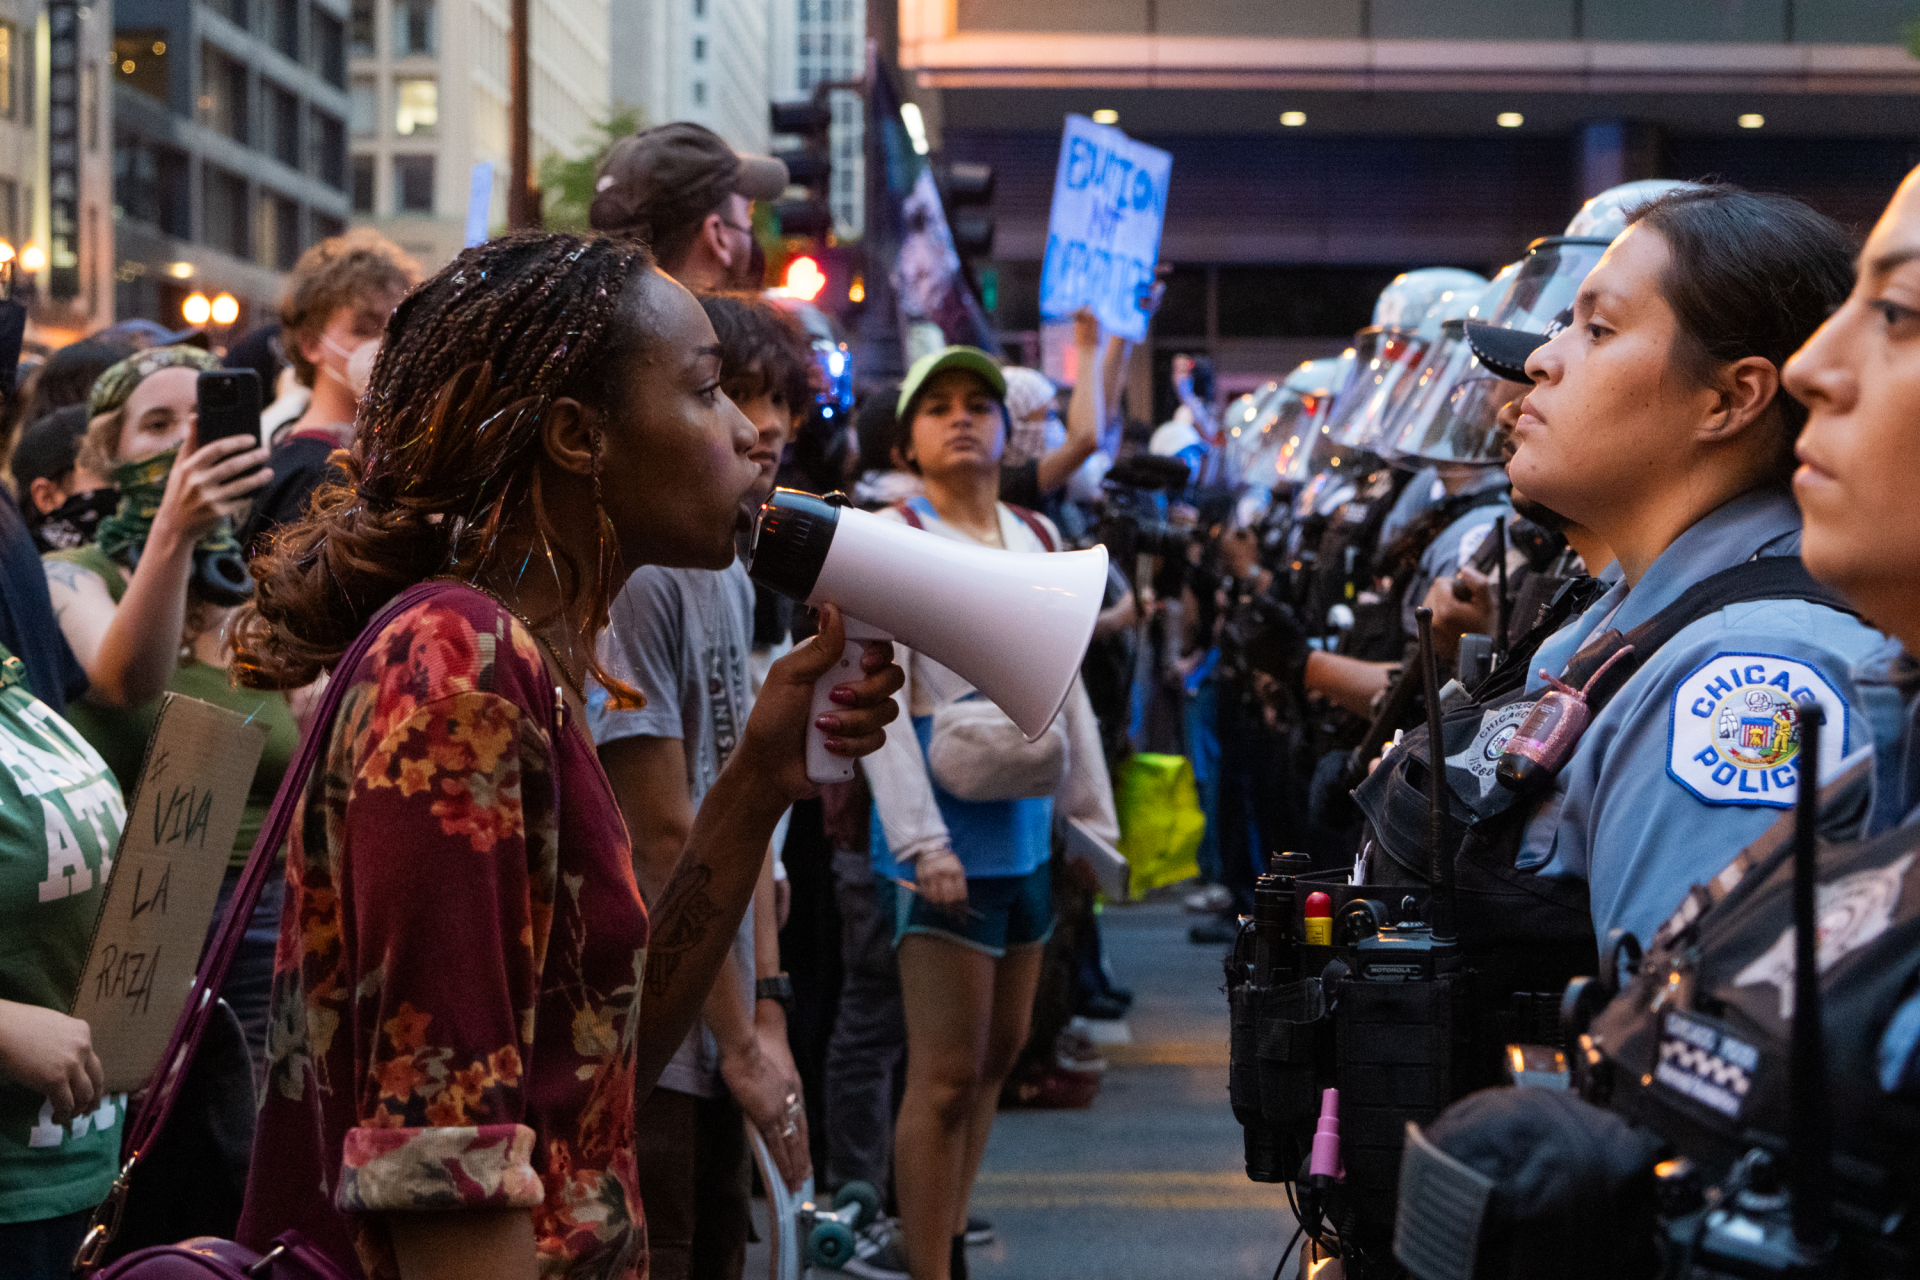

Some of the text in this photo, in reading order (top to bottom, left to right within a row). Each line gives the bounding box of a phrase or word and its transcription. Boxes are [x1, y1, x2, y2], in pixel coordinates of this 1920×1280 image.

[1691, 664, 1827, 726] CHICAG
[1479, 710, 1530, 739] CHICAGO
[150, 751, 170, 783] #
[1693, 744, 1800, 793] POLIC
[154, 785, 212, 847] VIVA
[130, 862, 172, 921] LA
